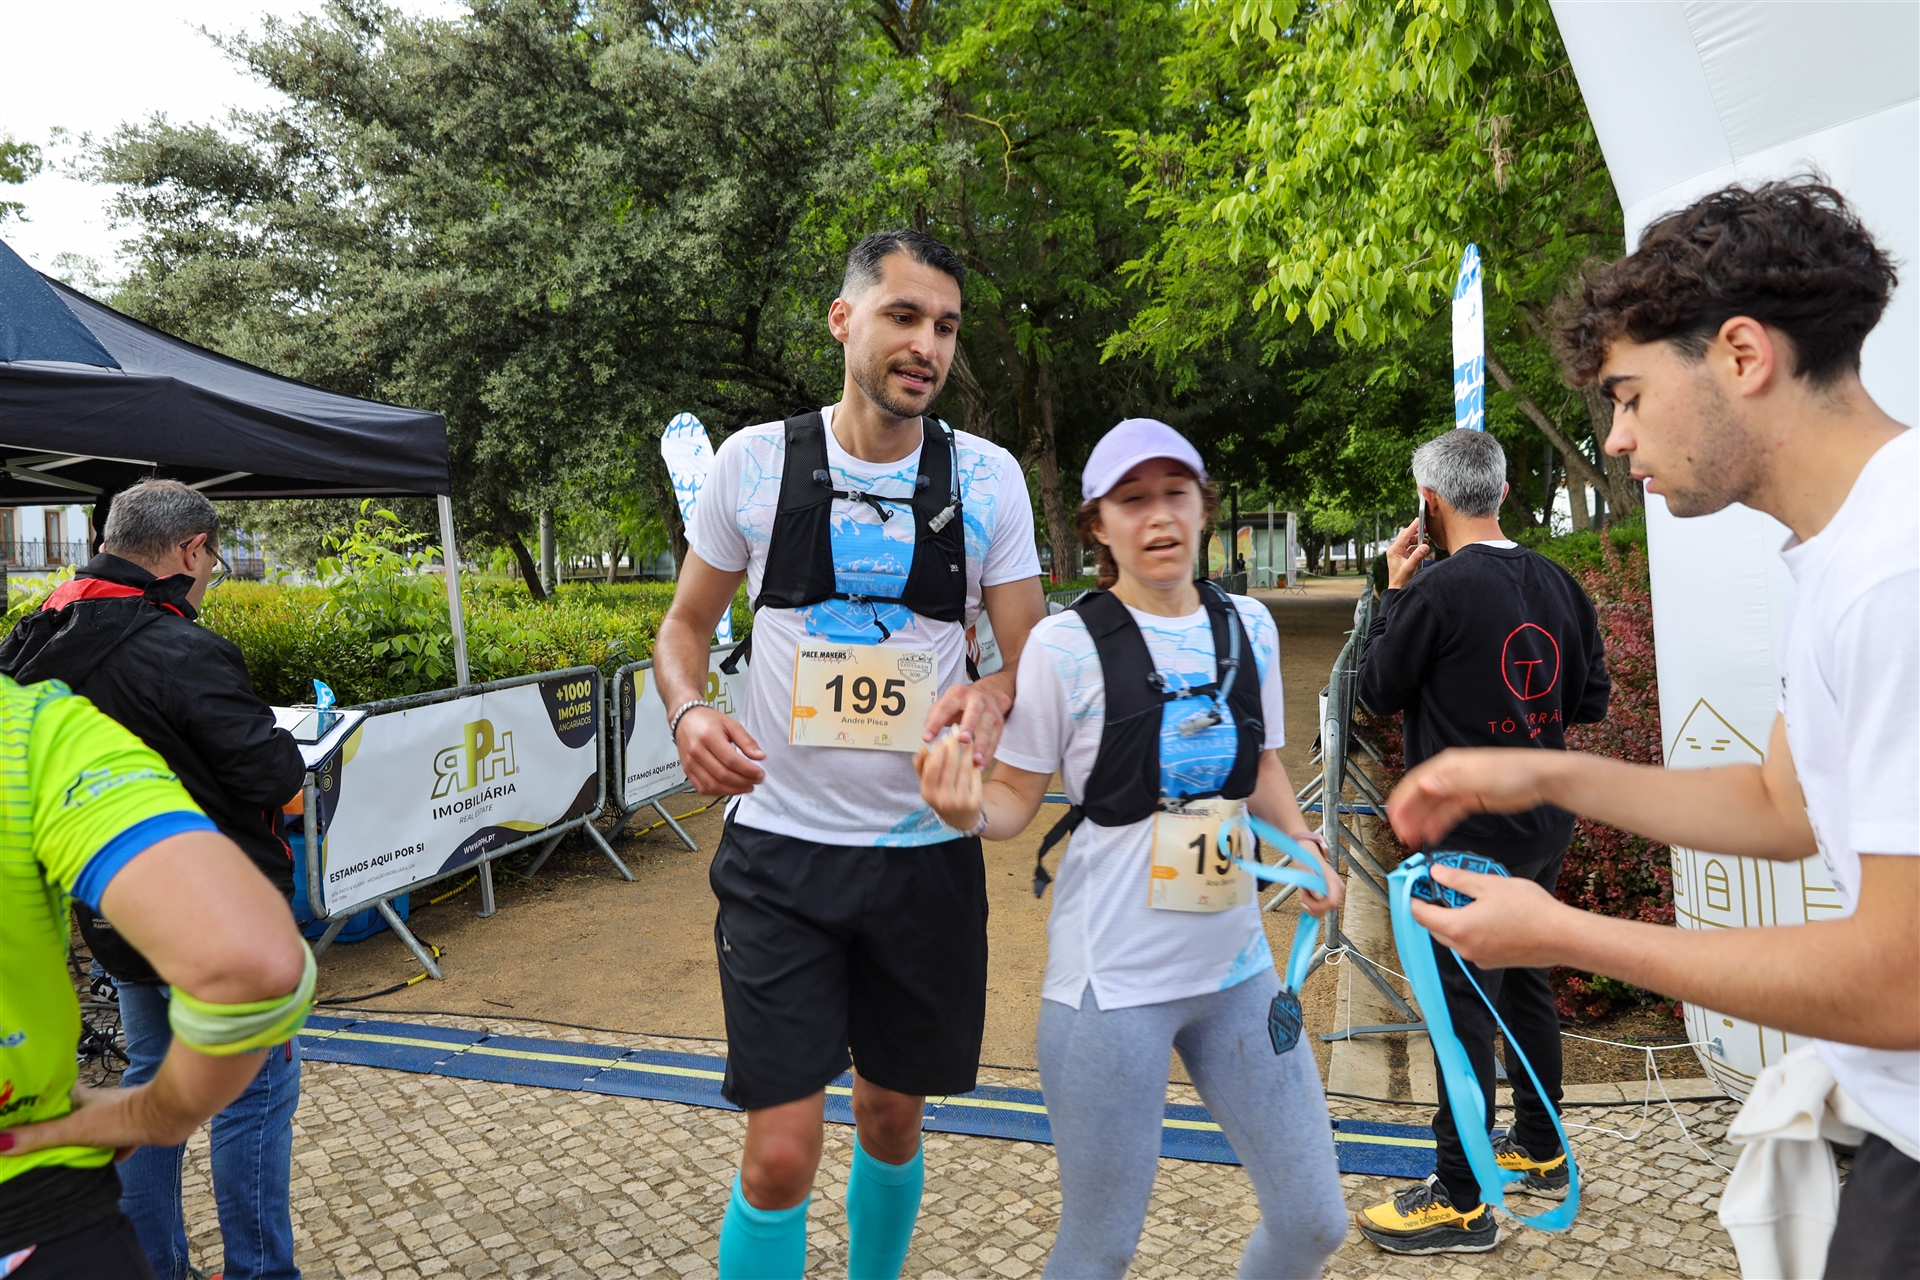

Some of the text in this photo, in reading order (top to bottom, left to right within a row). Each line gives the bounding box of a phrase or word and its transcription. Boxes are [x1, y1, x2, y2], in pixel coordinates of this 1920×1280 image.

[836, 582, 900, 594] NTARÉM
[819, 651, 847, 660] MAKERS
[556, 679, 591, 702] +1000
[825, 674, 906, 717] 195
[558, 701, 592, 720] IMÓVEIS
[558, 716, 592, 733] ANGARIADOS
[841, 716, 889, 727] Andre Pisca
[627, 769, 651, 784] ESTAMOS
[652, 765, 665, 775] AQUI
[666, 761, 676, 770] POR
[432, 783, 517, 820] IMOBILIÁRIA
[459, 803, 494, 825] REAL ESTATE
[329, 842, 425, 883] ESTAMOS AQUI POR SI
[1404, 1212, 1452, 1229] new balance
